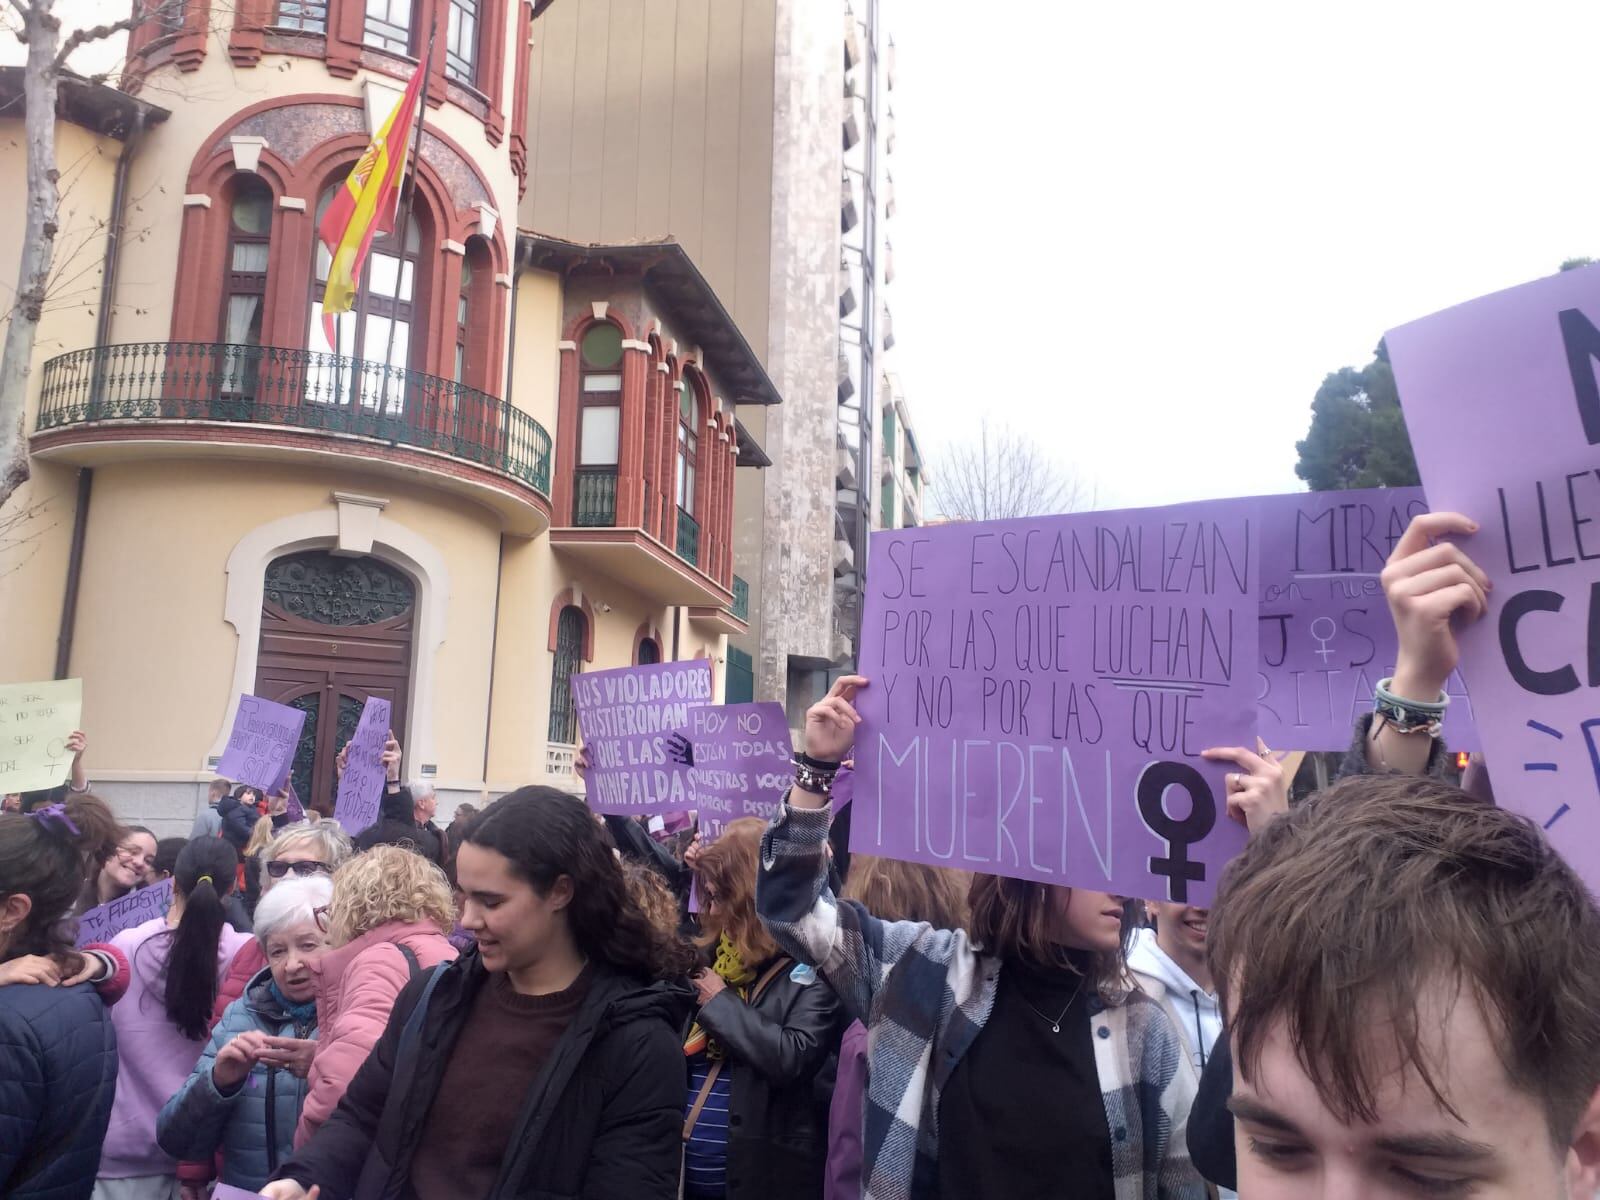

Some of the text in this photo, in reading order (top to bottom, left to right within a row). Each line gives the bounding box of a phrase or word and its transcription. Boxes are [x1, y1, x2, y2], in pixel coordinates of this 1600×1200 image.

[1290, 499, 1430, 572] MIRA
[1497, 469, 1600, 574] LLE
[882, 518, 1250, 600] SE ESCANDALIZAN
[882, 603, 1233, 682] POR LAS QUE LUCHAN
[576, 668, 712, 709] LOS VIOLADORES
[580, 703, 661, 738] EXISTIERON
[694, 711, 762, 736] HOY NO
[882, 673, 1204, 758] Y NO POR LAS QUE
[597, 736, 668, 769] QUE LAS
[732, 740, 789, 760] TODAS
[237, 756, 271, 792] SOL
[595, 767, 698, 806] MINIFALDAS
[694, 768, 749, 793] NUESTRAS
[743, 799, 779, 818] DESD
[876, 732, 1113, 882] MUEREN
[85, 911, 104, 929] TE
